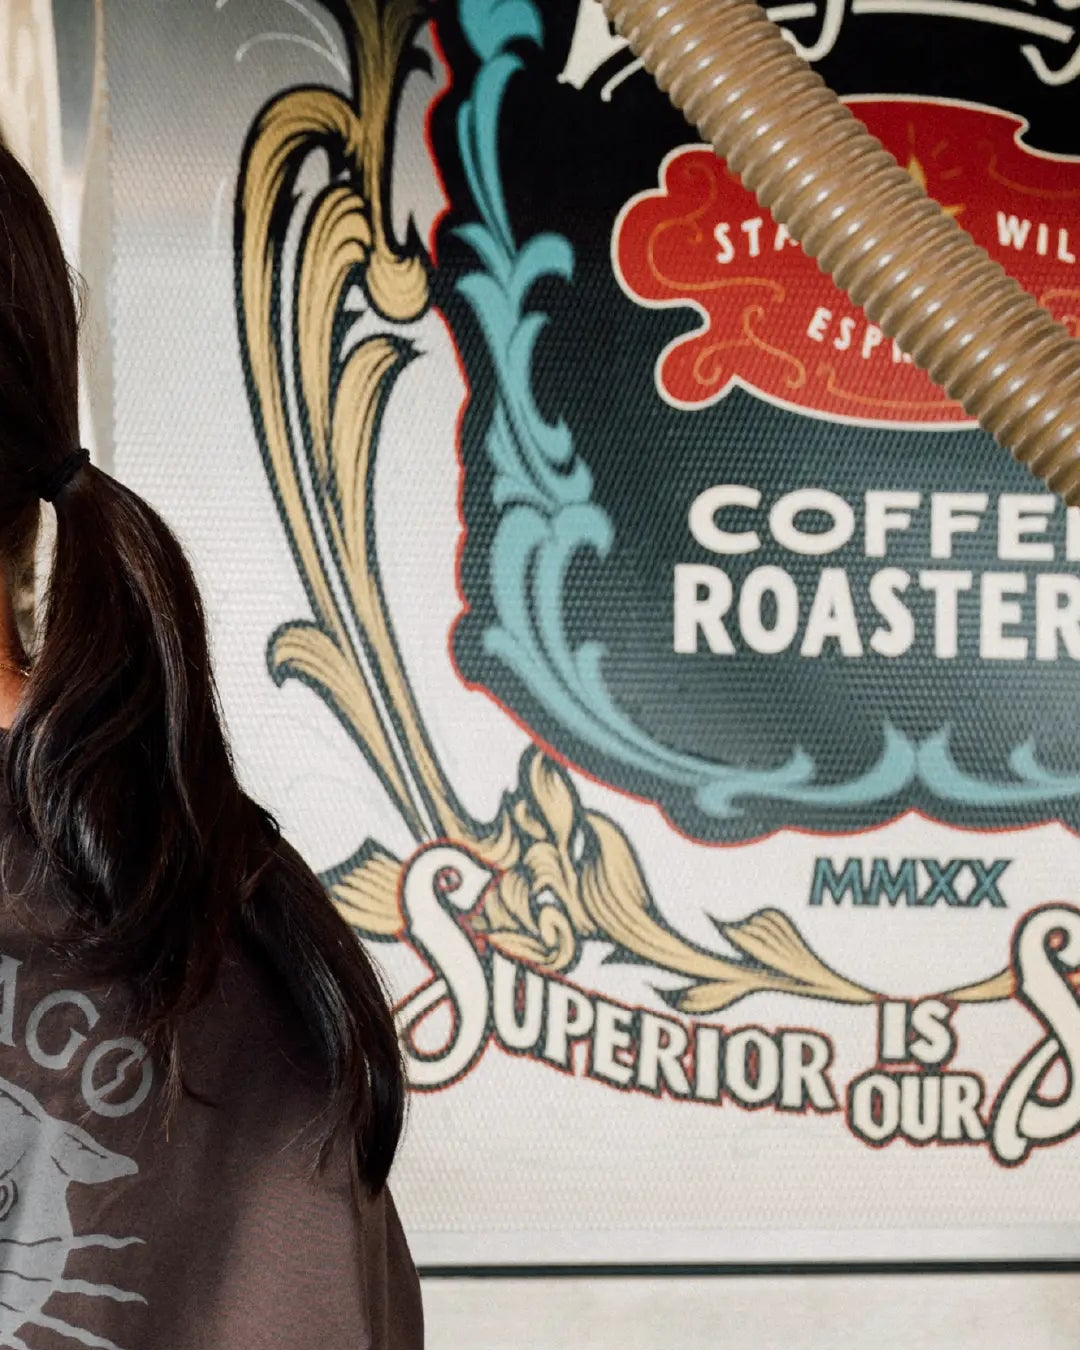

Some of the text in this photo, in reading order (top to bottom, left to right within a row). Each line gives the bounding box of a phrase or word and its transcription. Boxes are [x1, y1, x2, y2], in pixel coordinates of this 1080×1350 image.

[688, 484, 1080, 561] COFFE
[673, 563, 1080, 660] ROASTER
[809, 857, 1014, 908] MMXX
[394, 840, 841, 1113] SUPERIOR
[877, 1000, 956, 1066] IS
[849, 1071, 991, 1144] OUR
